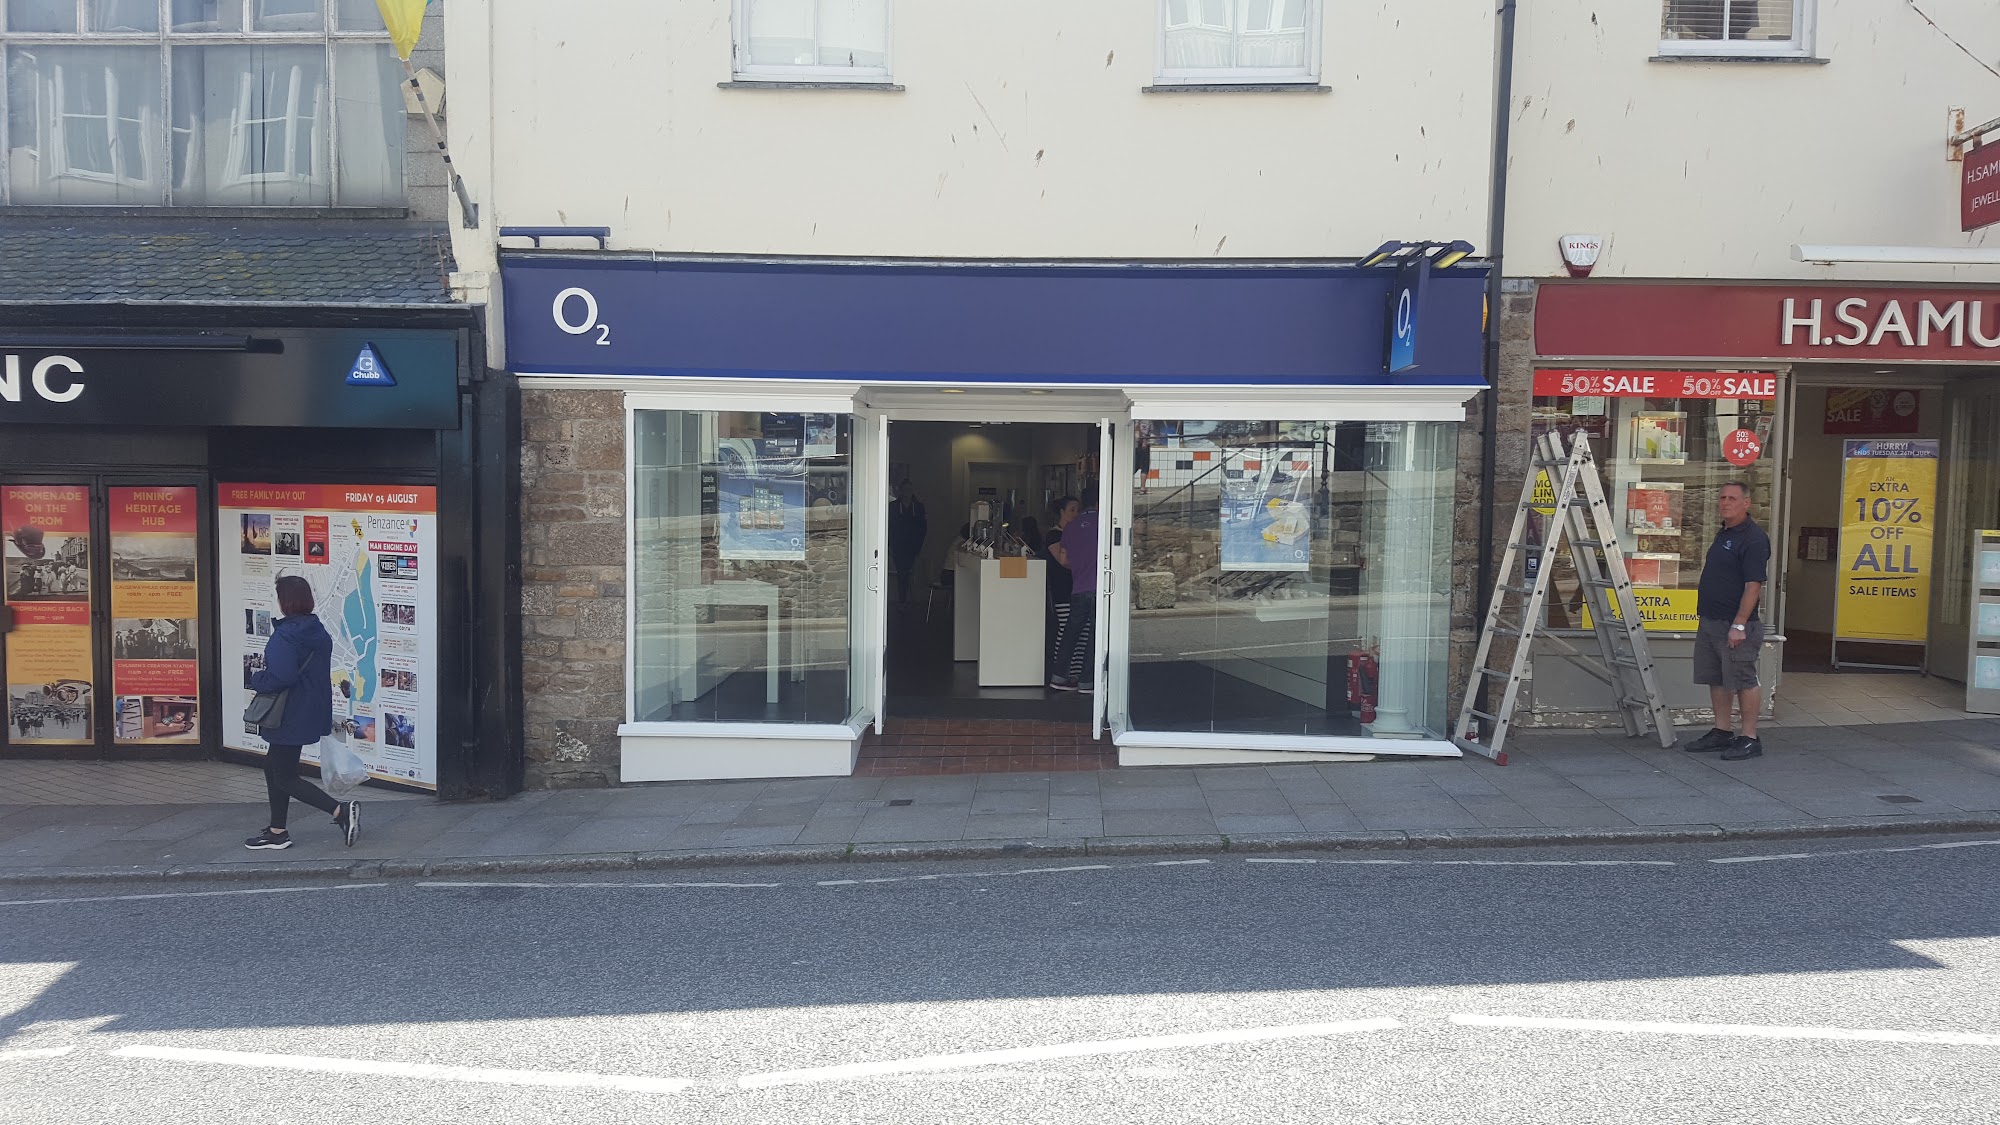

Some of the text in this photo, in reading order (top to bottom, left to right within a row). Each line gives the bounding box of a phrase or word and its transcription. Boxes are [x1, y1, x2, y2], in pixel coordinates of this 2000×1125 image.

[1967, 160, 2000, 184] H.SAM
[353, 371, 380, 379] Chubb
[1602, 375, 1655, 393] SALE
[1723, 378, 1775, 396] SALE
[1827, 409, 1862, 422] SALE
[1876, 442, 1909, 450] HURRY!
[1869, 482, 1910, 493] EXTRA
[9, 490, 82, 500] PROMENADE
[133, 491, 173, 501] MINING
[231, 490, 306, 500] FREE FAMILY DAY OUT
[345, 492, 418, 504] FRIDAY 05 AUGUST
[25, 503, 67, 513] ON THE
[125, 503, 182, 514] HERITAGE
[1855, 497, 1922, 524] 10%
[30, 516, 63, 526] PROM
[142, 517, 166, 526] HUB
[367, 515, 405, 530] Penzance
[354, 528, 362, 536] PZ
[1870, 526, 1904, 539] OFF
[369, 542, 418, 552] MAN ENGINE DAY
[1851, 543, 1919, 573] ALL
[1849, 585, 1878, 596] SALE
[1635, 596, 1671, 607] EXTRA
